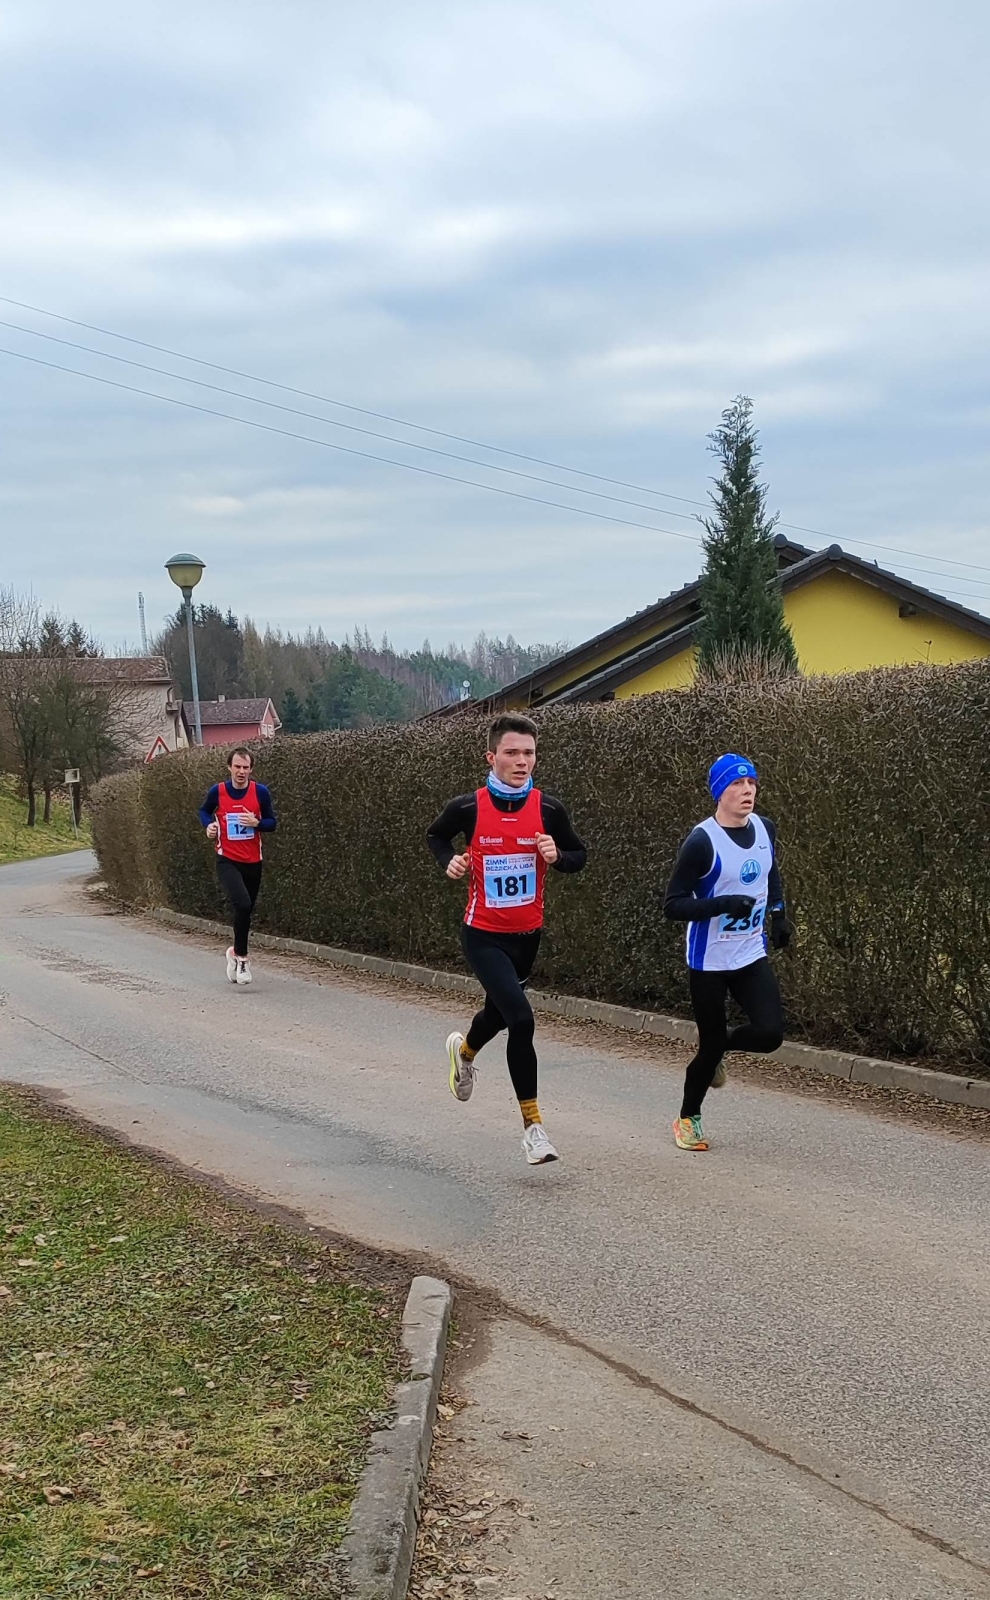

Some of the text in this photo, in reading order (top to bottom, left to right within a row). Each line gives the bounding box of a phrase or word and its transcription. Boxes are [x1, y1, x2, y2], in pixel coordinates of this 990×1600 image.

[234, 824, 247, 834] 12
[493, 875, 527, 897] 181
[723, 909, 762, 931] 236
